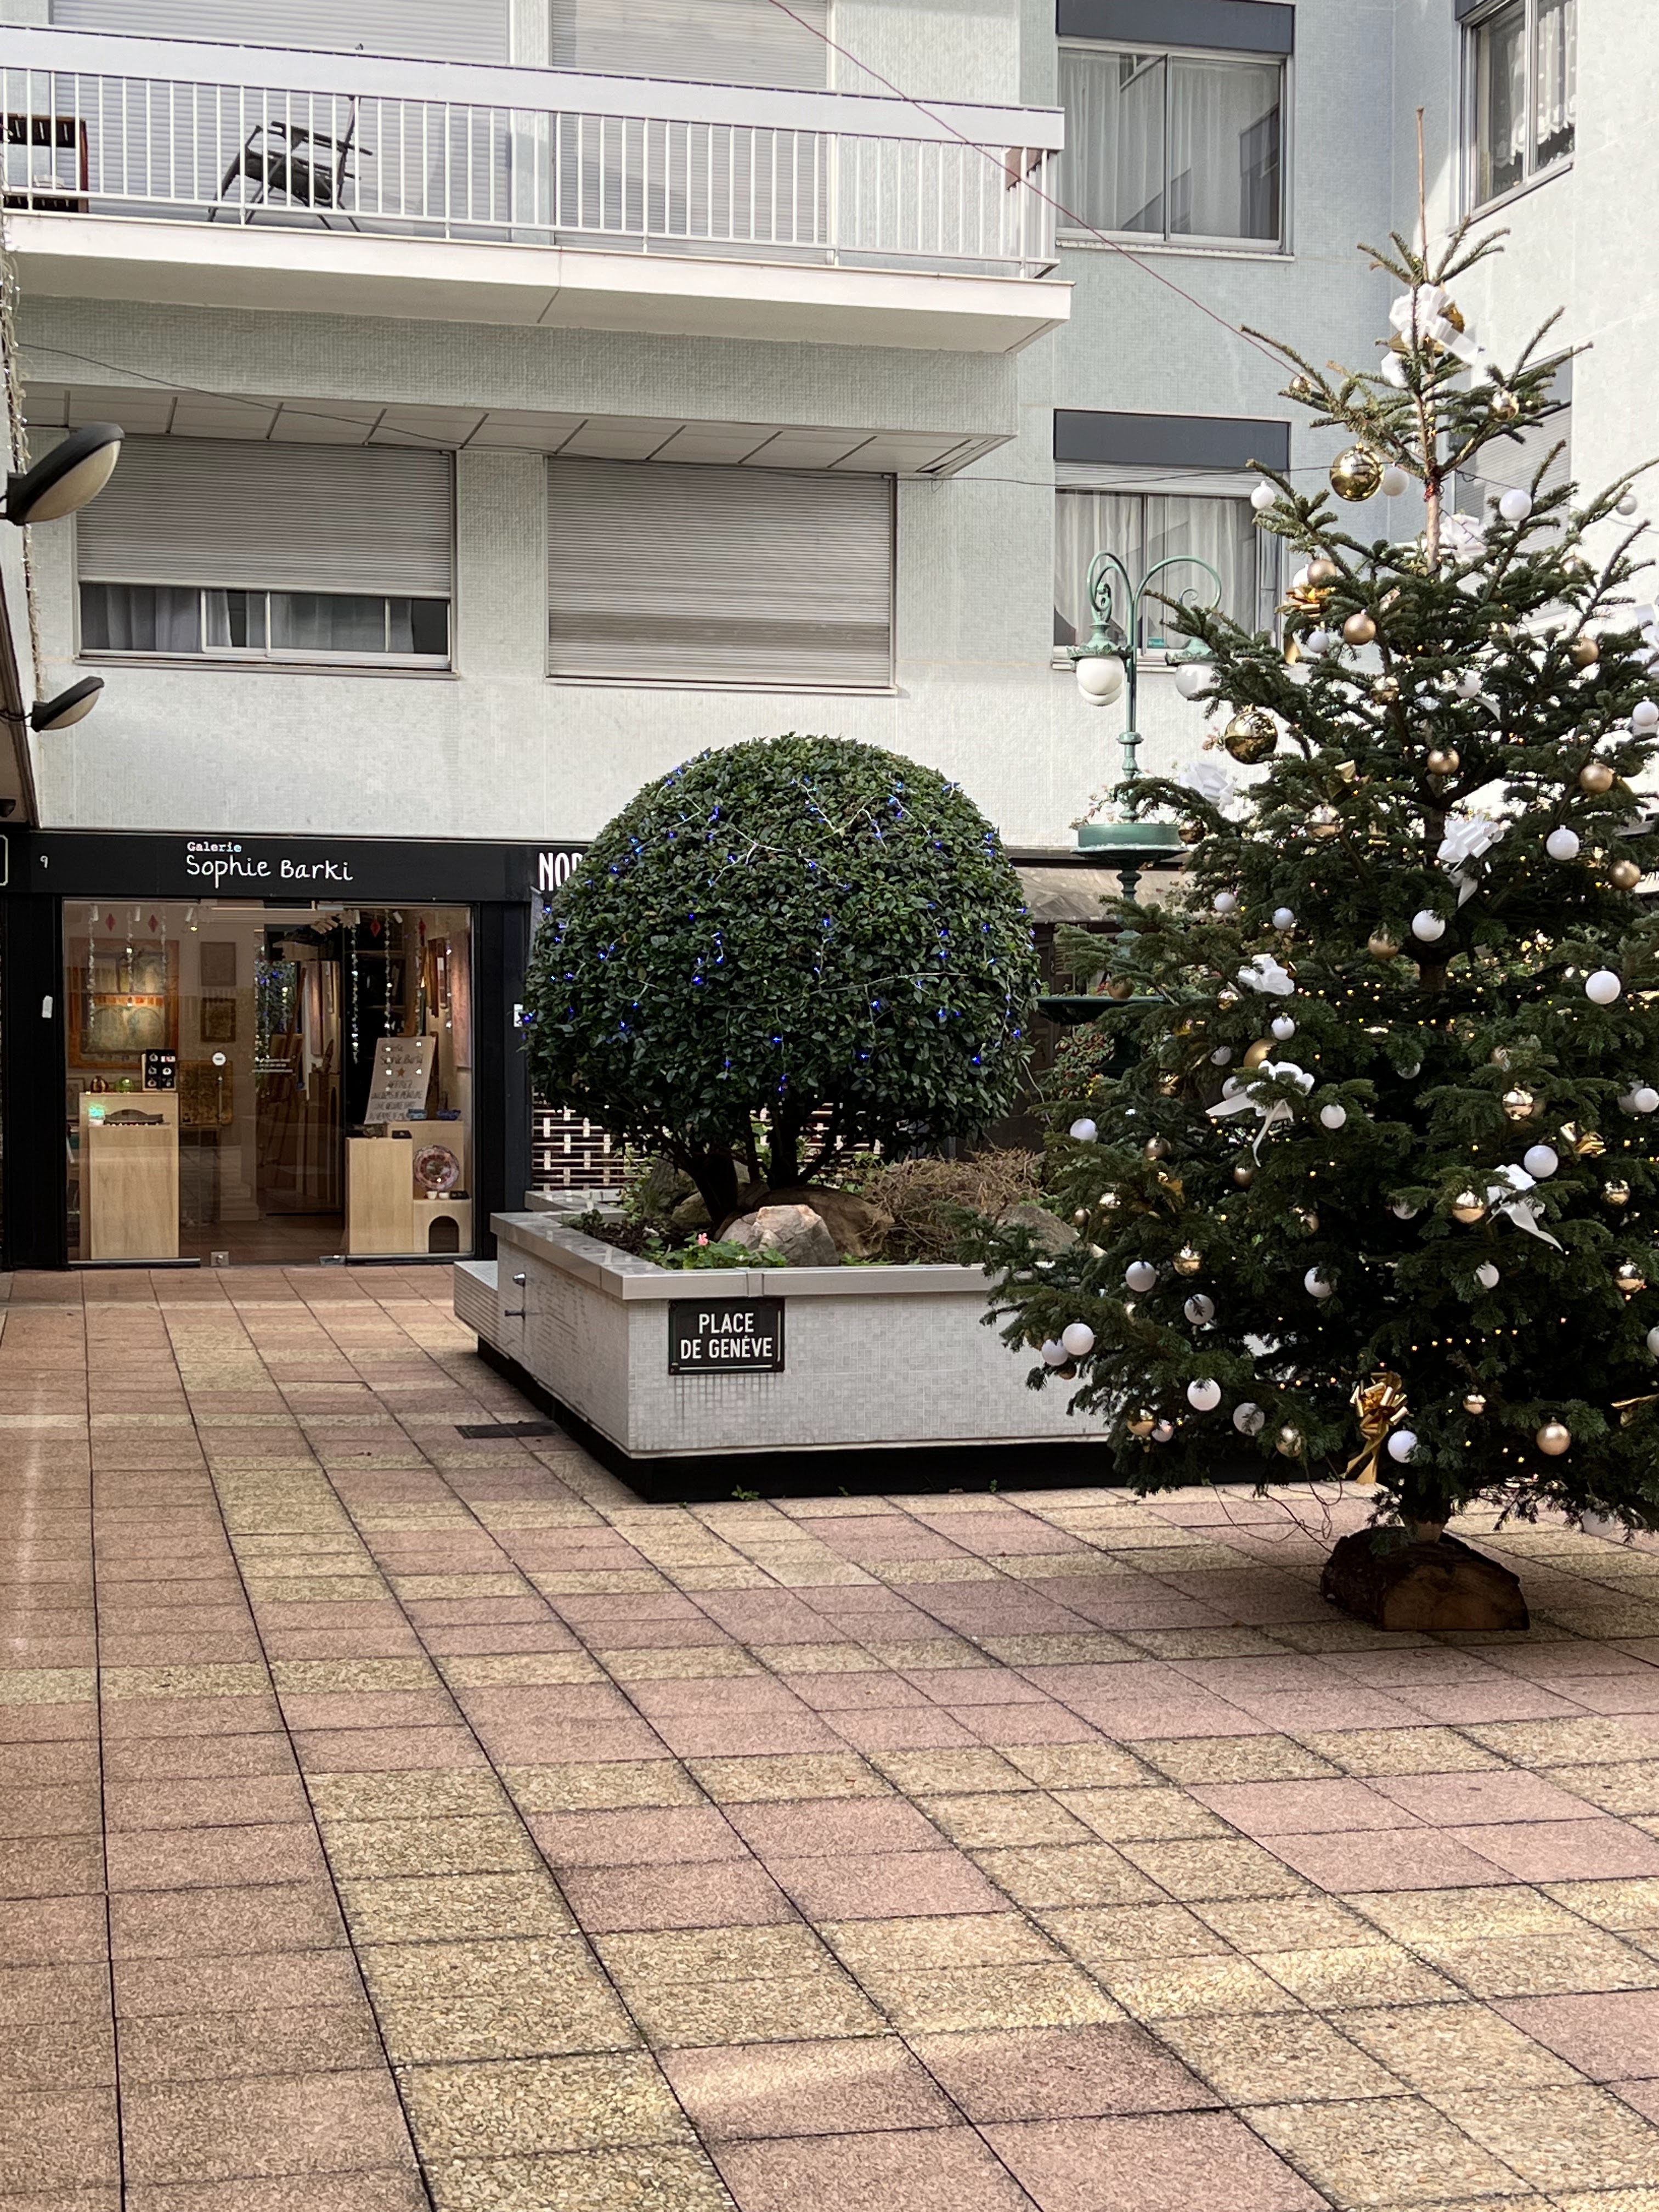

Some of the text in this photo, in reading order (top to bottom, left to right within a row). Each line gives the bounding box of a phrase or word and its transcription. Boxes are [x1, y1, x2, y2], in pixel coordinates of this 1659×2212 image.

[187, 842, 241, 852] Galerie
[40, 855, 48, 868] 9
[187, 855, 353, 889] Sophie Barki
[699, 1313, 754, 1334] PLACE
[680, 1334, 773, 1359] DE GENÈVE
